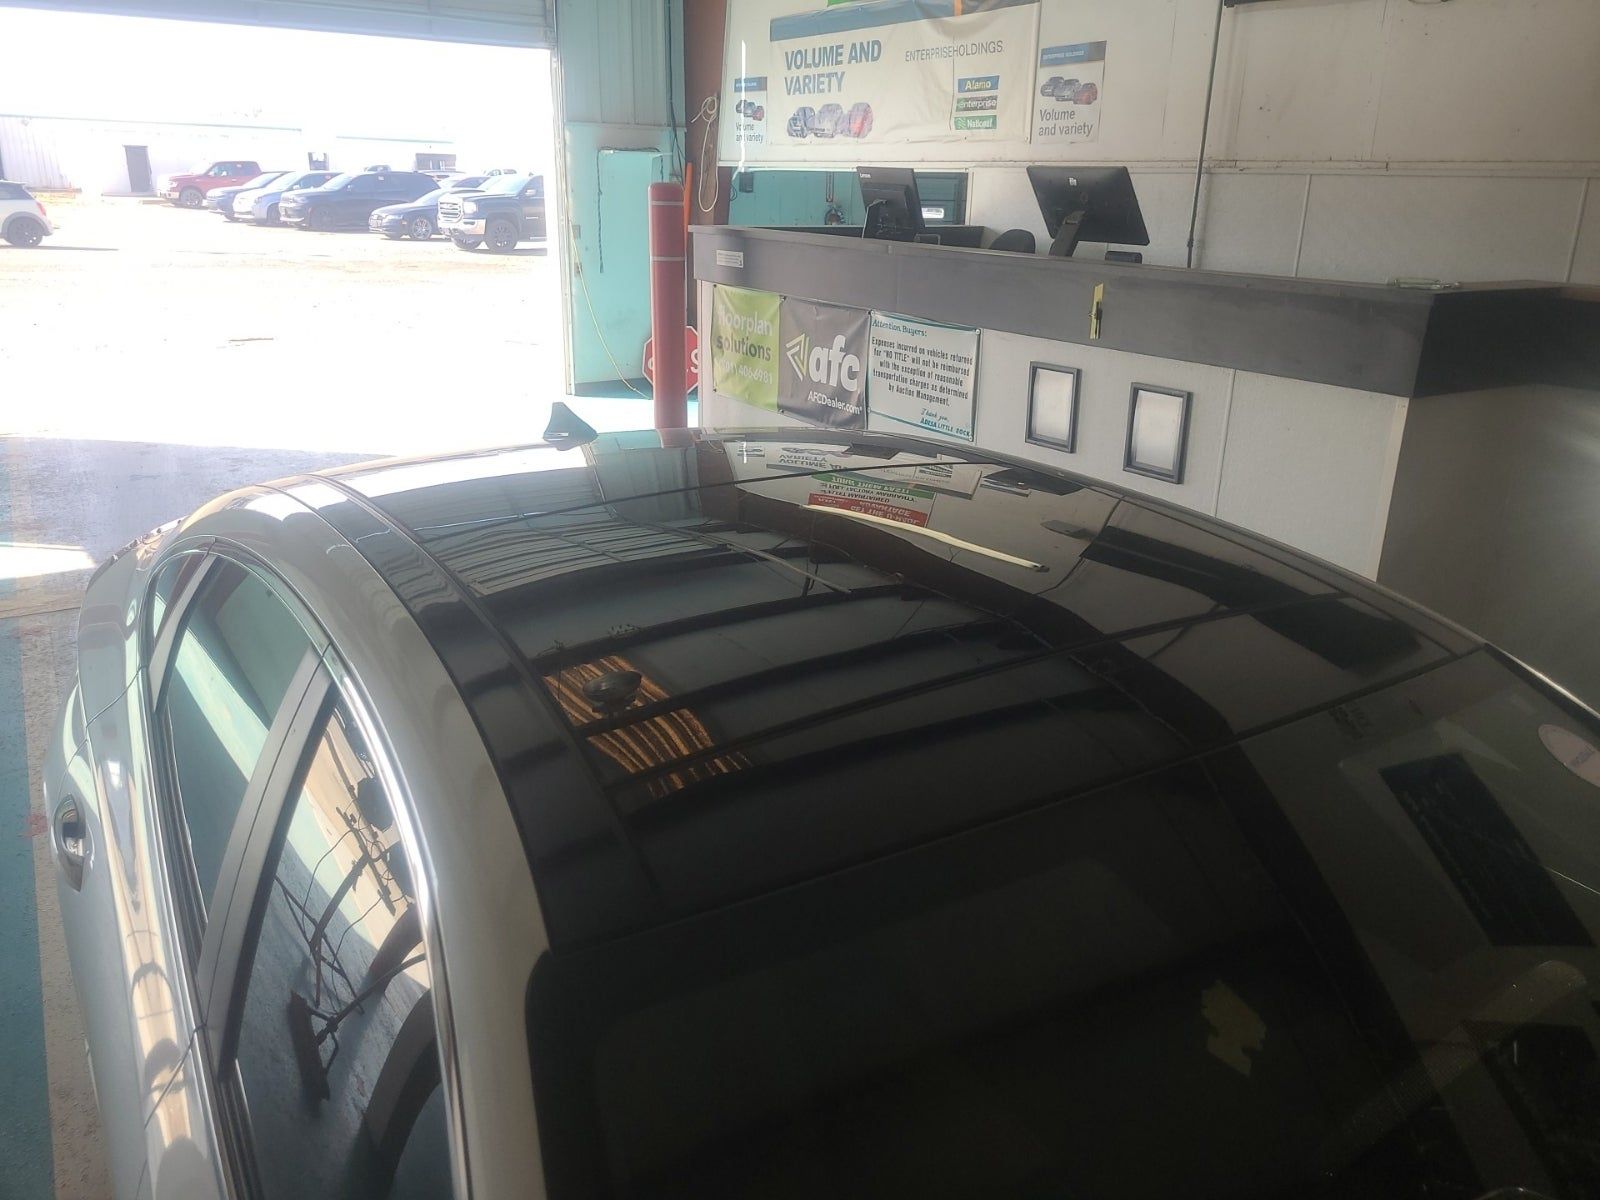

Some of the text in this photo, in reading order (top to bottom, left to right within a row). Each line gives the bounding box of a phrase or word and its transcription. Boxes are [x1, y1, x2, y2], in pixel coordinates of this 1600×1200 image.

[784, 39, 882, 71] VOLUME AND
[784, 71, 846, 96] VARIETY
[965, 80, 992, 90] Alamo
[967, 118, 993, 129] National
[1039, 109, 1076, 122] Volume
[1039, 122, 1094, 138] and variety
[902, 324, 928, 337] Buyers:
[716, 332, 772, 361] solutions
[872, 336, 973, 366] Expenses incurred on vehicles returned
[808, 334, 860, 392] afc
[880, 360, 963, 387] with the exception of reasonable
[911, 356, 920, 365] will
[922, 358, 930, 367] not
[932, 360, 938, 369] be
[940, 363, 970, 377] reimbursed
[873, 368, 968, 400] transportation charges as determined
[888, 382, 951, 406] by Auction Management.
[920, 407, 938, 419] Thank
[920, 418, 937, 429] ADESA
[937, 421, 954, 433] LITTLE
